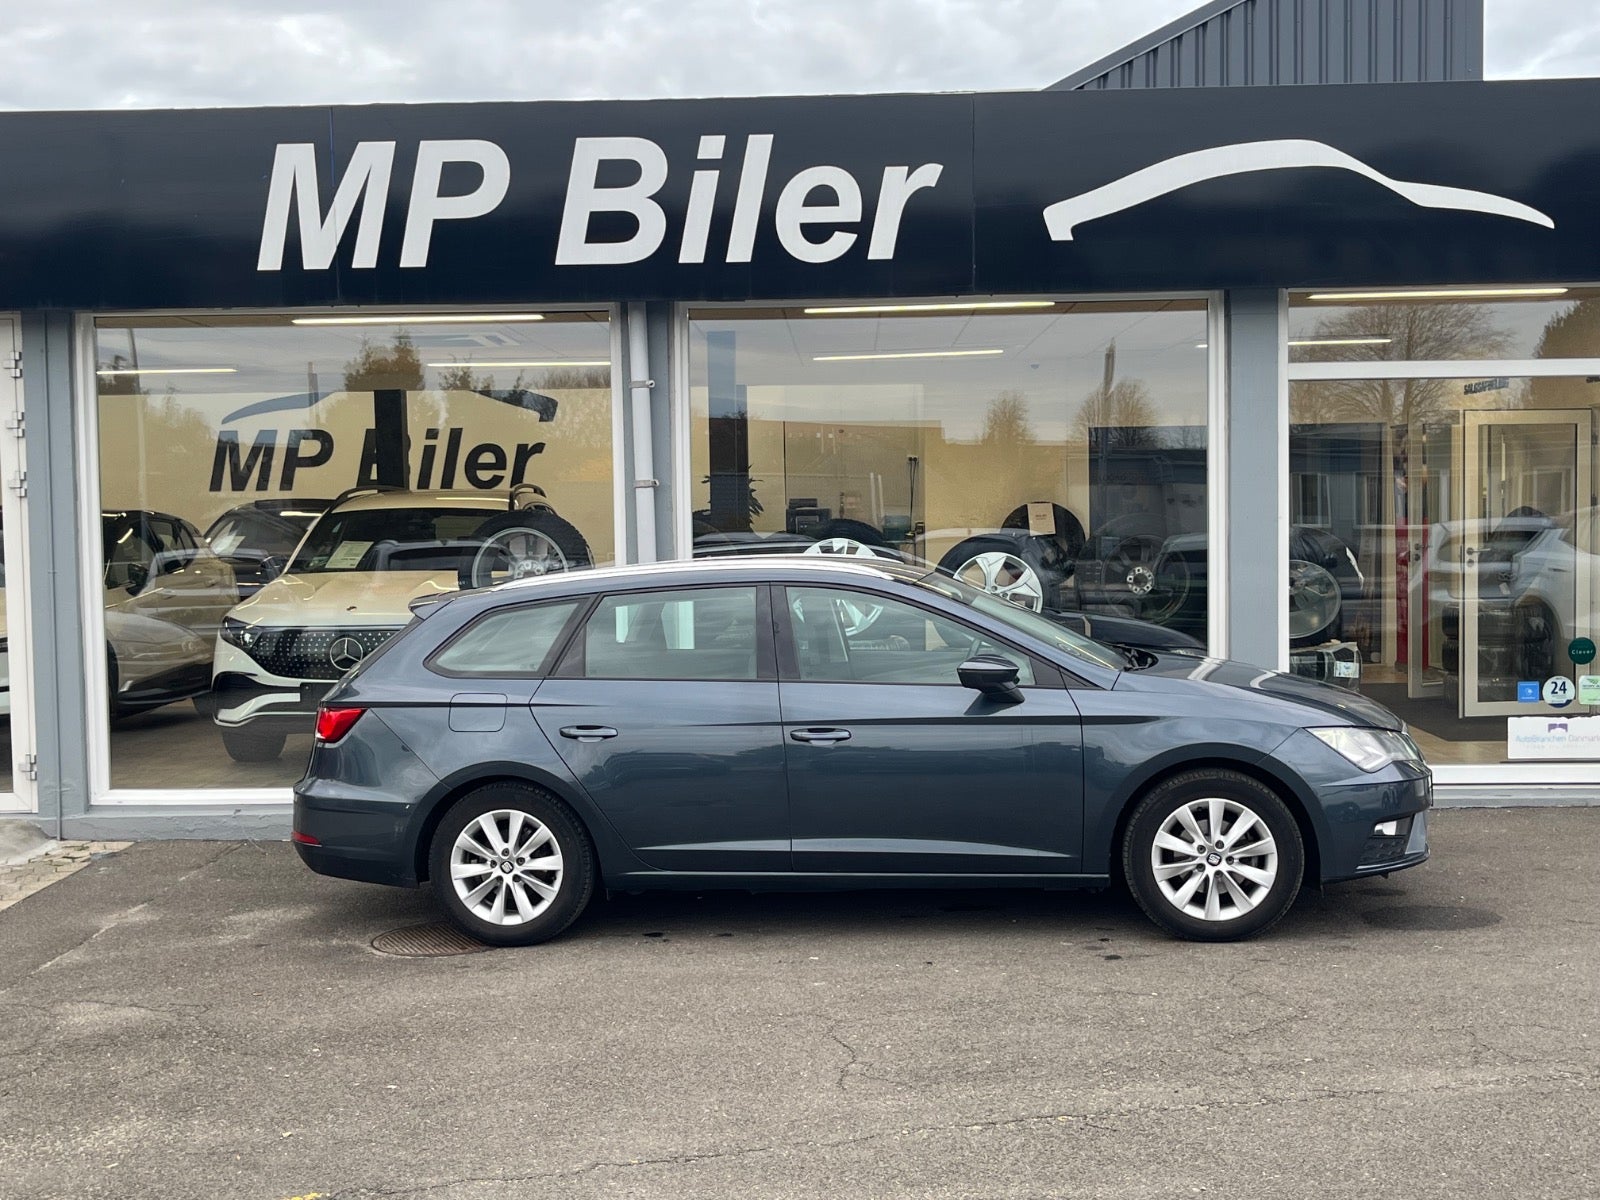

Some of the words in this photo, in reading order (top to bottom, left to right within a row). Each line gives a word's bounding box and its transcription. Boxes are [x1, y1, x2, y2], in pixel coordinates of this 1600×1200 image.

[257, 139, 510, 271] MP
[555, 134, 943, 265] Biler
[209, 428, 334, 492] MP
[1550, 681, 1567, 695] 24
